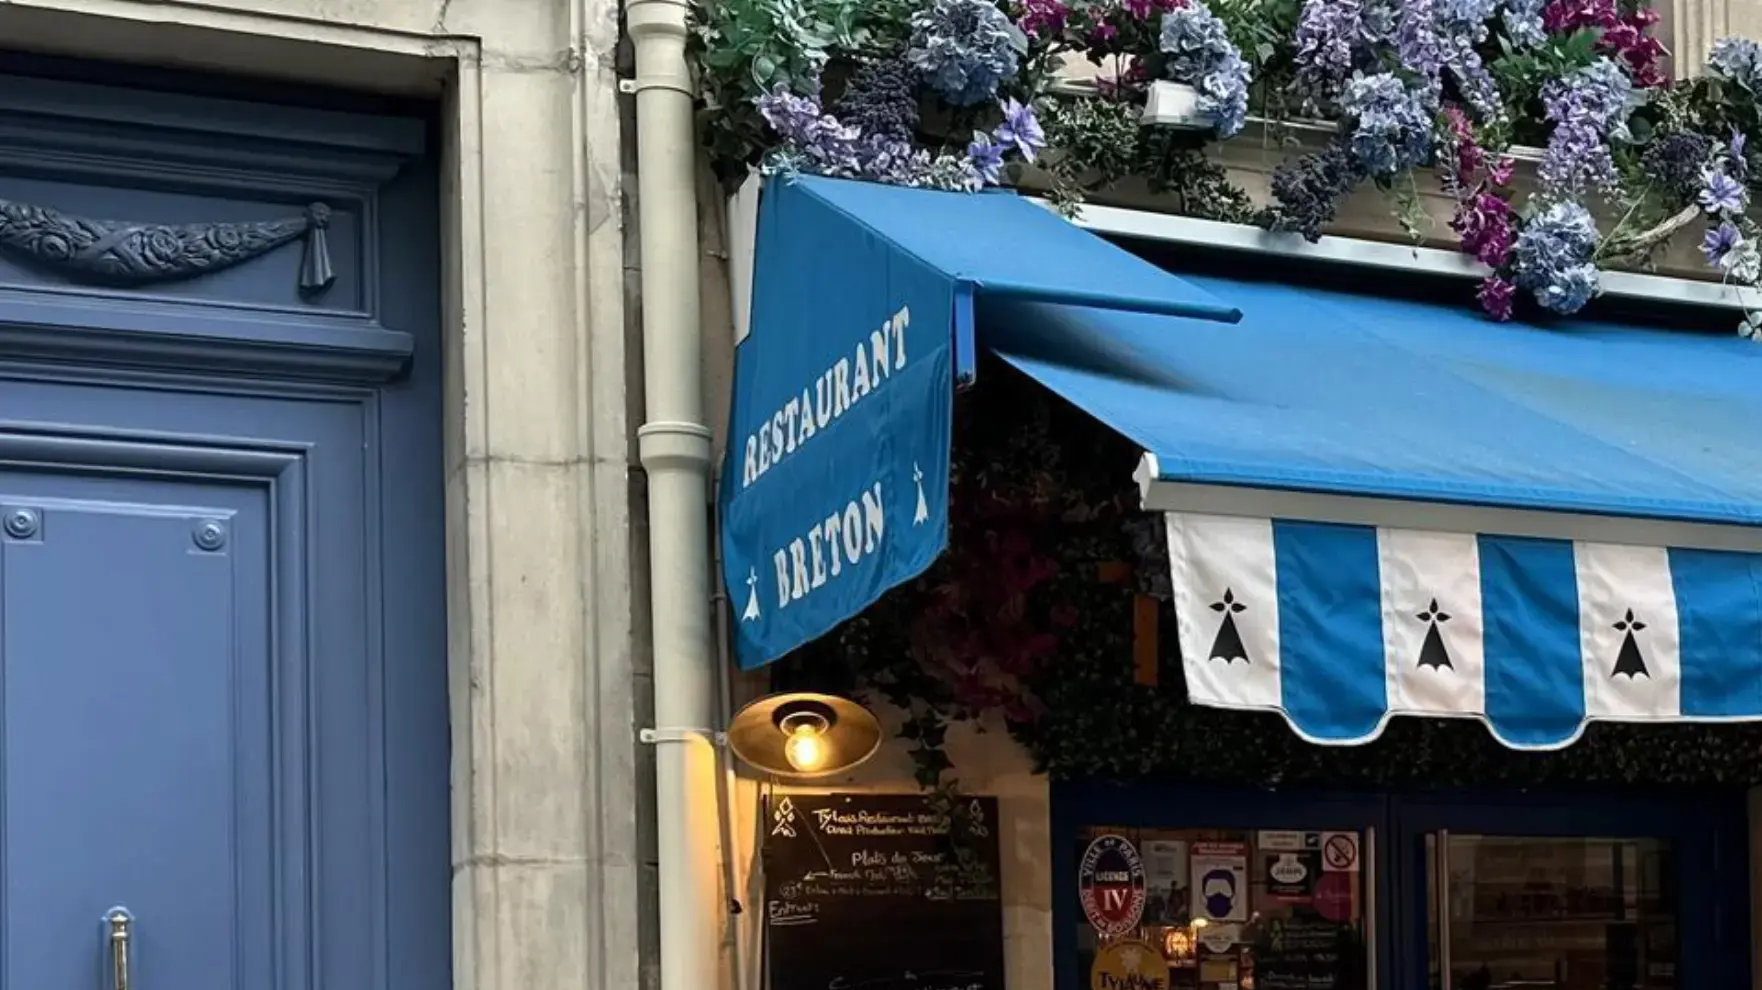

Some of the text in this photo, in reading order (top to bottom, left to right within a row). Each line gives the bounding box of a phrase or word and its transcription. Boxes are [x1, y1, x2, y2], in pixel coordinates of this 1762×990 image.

[742, 306, 910, 488] RESTAURANT
[773, 482, 885, 608] BRETON
[1102, 889, 1128, 912] IV
